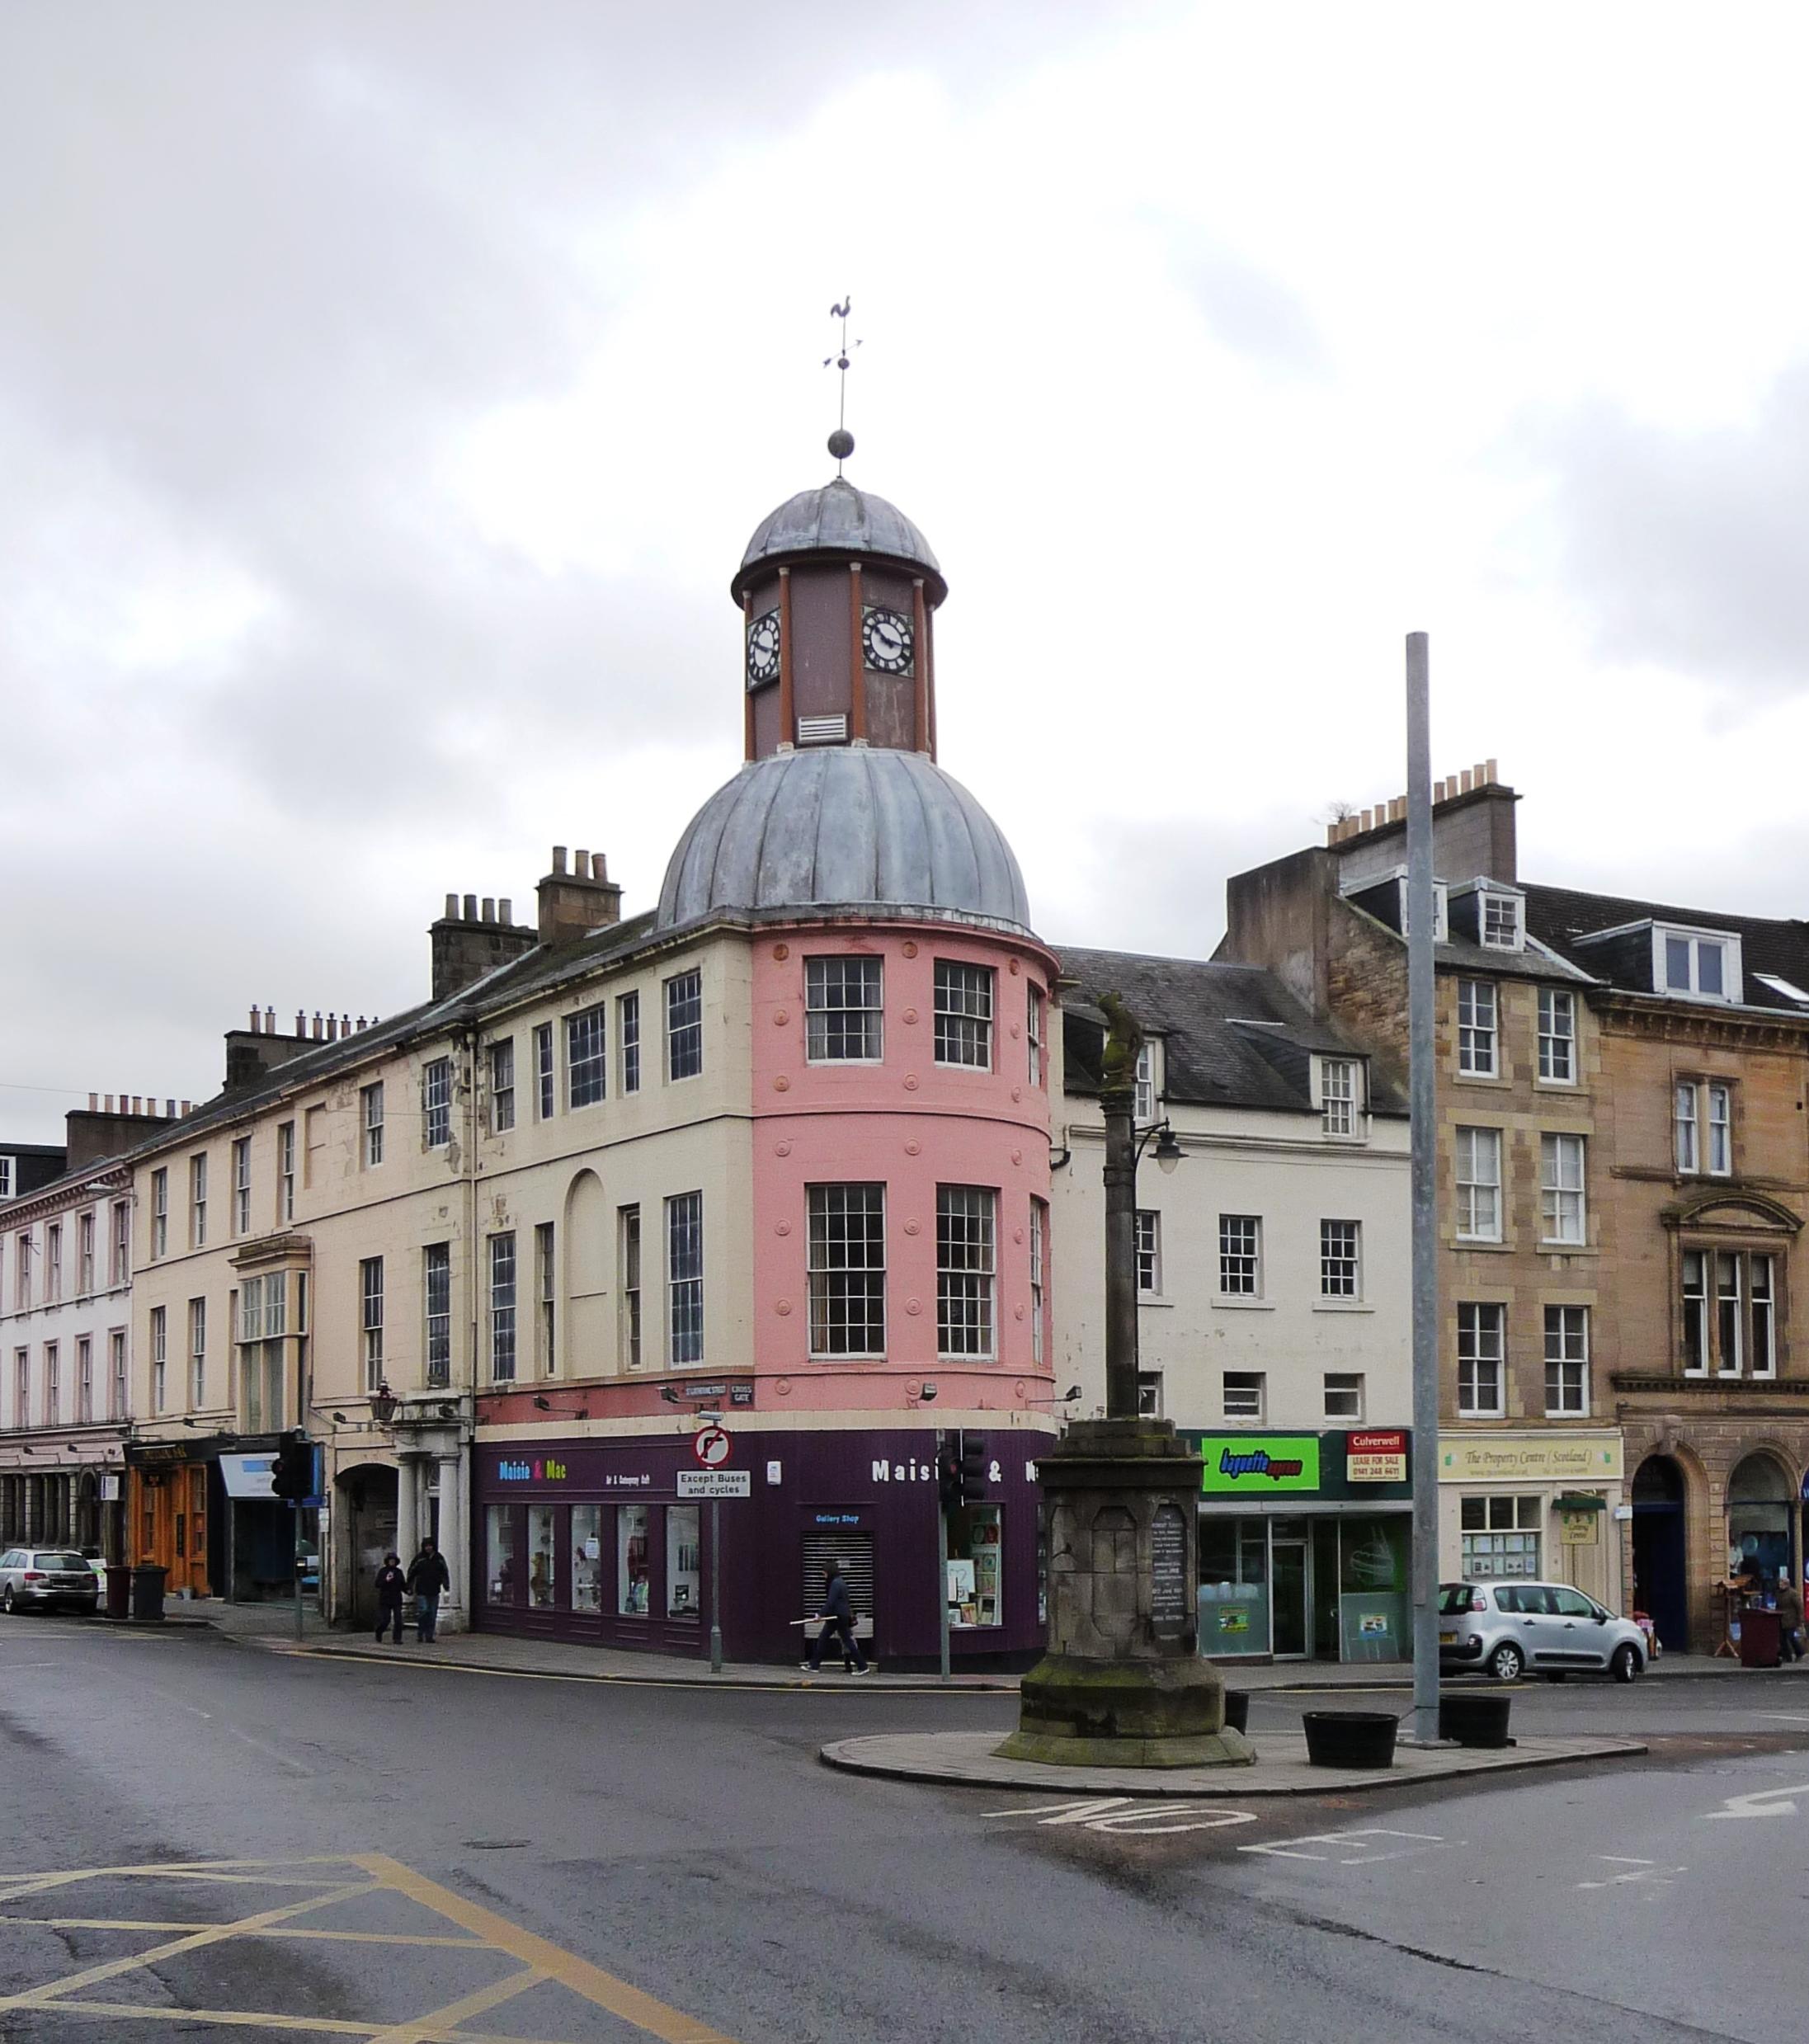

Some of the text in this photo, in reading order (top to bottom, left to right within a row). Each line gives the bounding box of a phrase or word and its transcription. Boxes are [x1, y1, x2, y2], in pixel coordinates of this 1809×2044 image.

[1353, 1436, 1400, 1446] Culverwell
[1353, 1457, 1370, 1465] LEASE
[1465, 1450, 1481, 1464] The
[1483, 1452, 1518, 1467] Property
[1520, 1451, 1546, 1464] Centre
[1220, 1448, 1270, 1480] baguette
[499, 1460, 566, 1480] Maisie & Mac
[872, 1458, 939, 1481] Maisi
[989, 1460, 1001, 1482] &
[681, 1474, 747, 1484] Except Buses
[688, 1486, 740, 1495] and cycles
[841, 1514, 860, 1524] Shop
